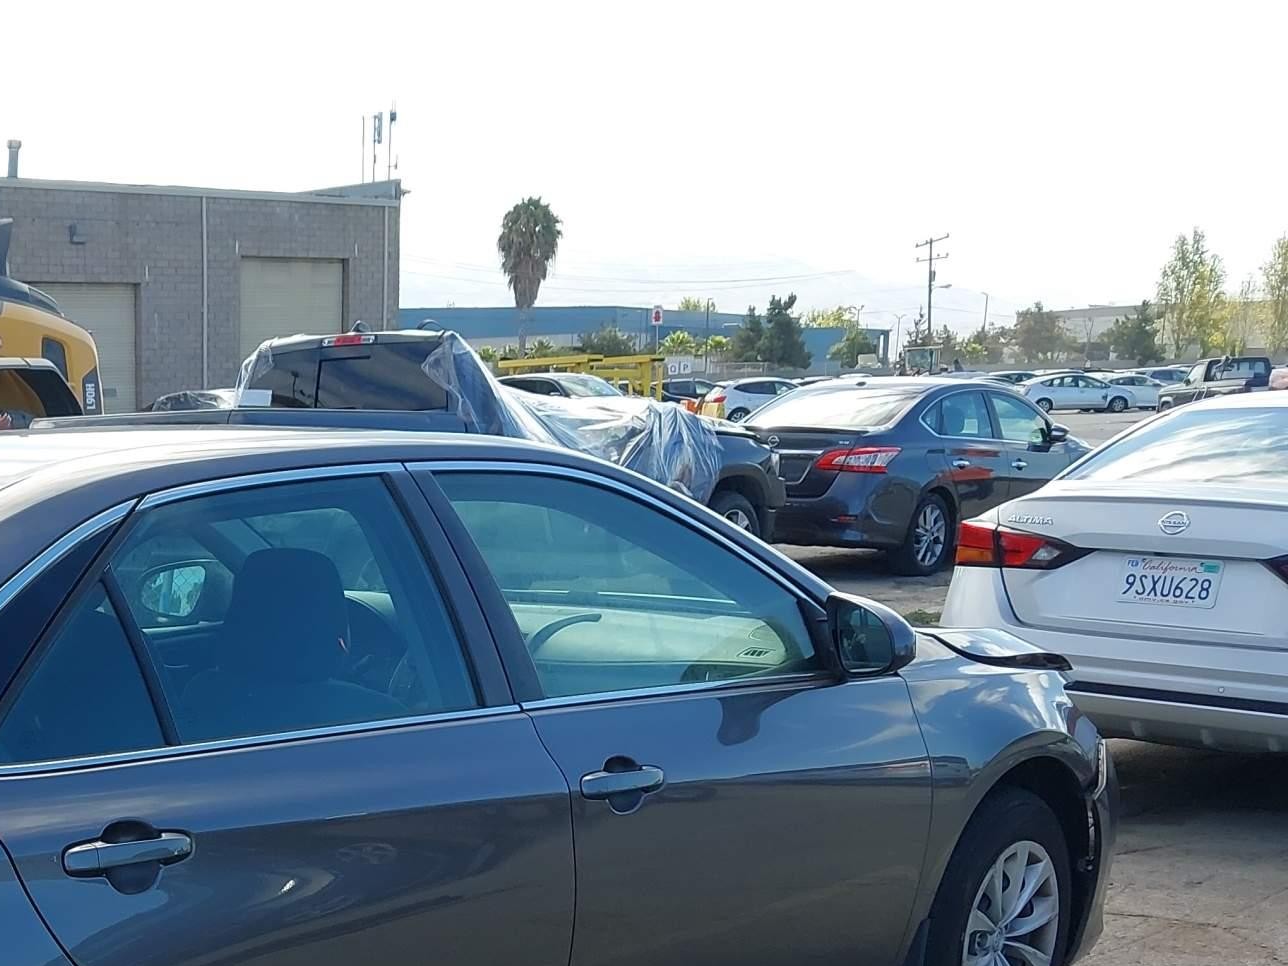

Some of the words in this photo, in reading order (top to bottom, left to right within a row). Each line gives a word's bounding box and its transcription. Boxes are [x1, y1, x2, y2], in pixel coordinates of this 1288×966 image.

[1007, 514, 1054, 526] ALTIMA
[1142, 559, 1204, 575] California
[1122, 573, 1212, 601] 9SXU628
